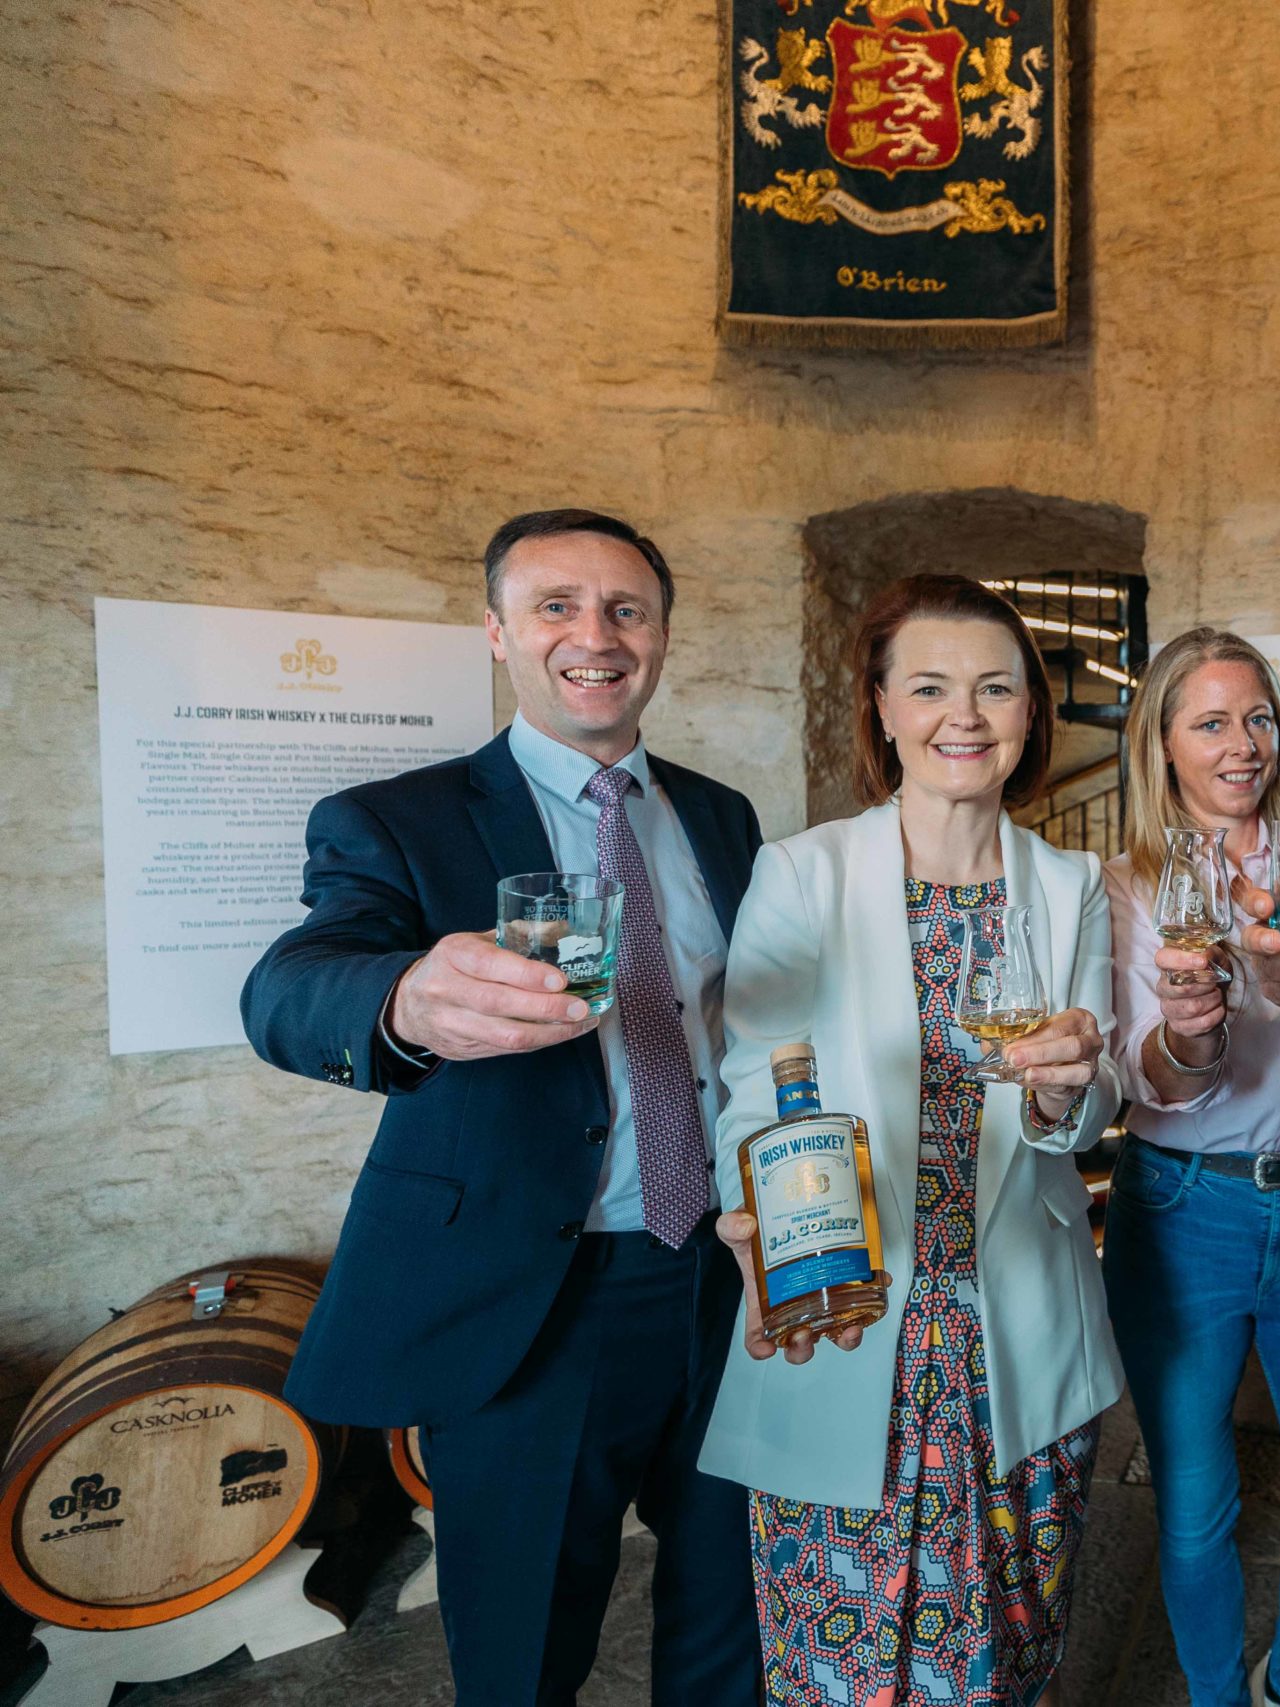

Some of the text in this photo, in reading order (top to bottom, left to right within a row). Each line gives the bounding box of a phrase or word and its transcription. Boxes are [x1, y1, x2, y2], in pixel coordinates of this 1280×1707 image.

[837, 266, 948, 292] O'Brien
[174, 706, 194, 719] J.J.
[197, 707, 232, 720] CORRY
[235, 708, 264, 721] IRISH
[266, 709, 316, 723] WHISKEY
[329, 712, 348, 724] THE
[350, 713, 385, 725] CLIFFS
[385, 714, 398, 726] OF
[400, 714, 434, 727] MOHER
[179, 740, 215, 750] special
[218, 741, 276, 752] partnership
[560, 961, 594, 971] CLIFFS
[759, 1142, 789, 1169] IRISH
[789, 1134, 846, 1155] WHISKEY
[768, 1230, 796, 1251] J.J.
[796, 1218, 859, 1236] CORRY
[110, 1404, 236, 1433] CASKNOLIA
[222, 1480, 272, 1497] CLIFFS
[222, 1487, 282, 1507] MOHER
[69, 1519, 125, 1533] CORRY
